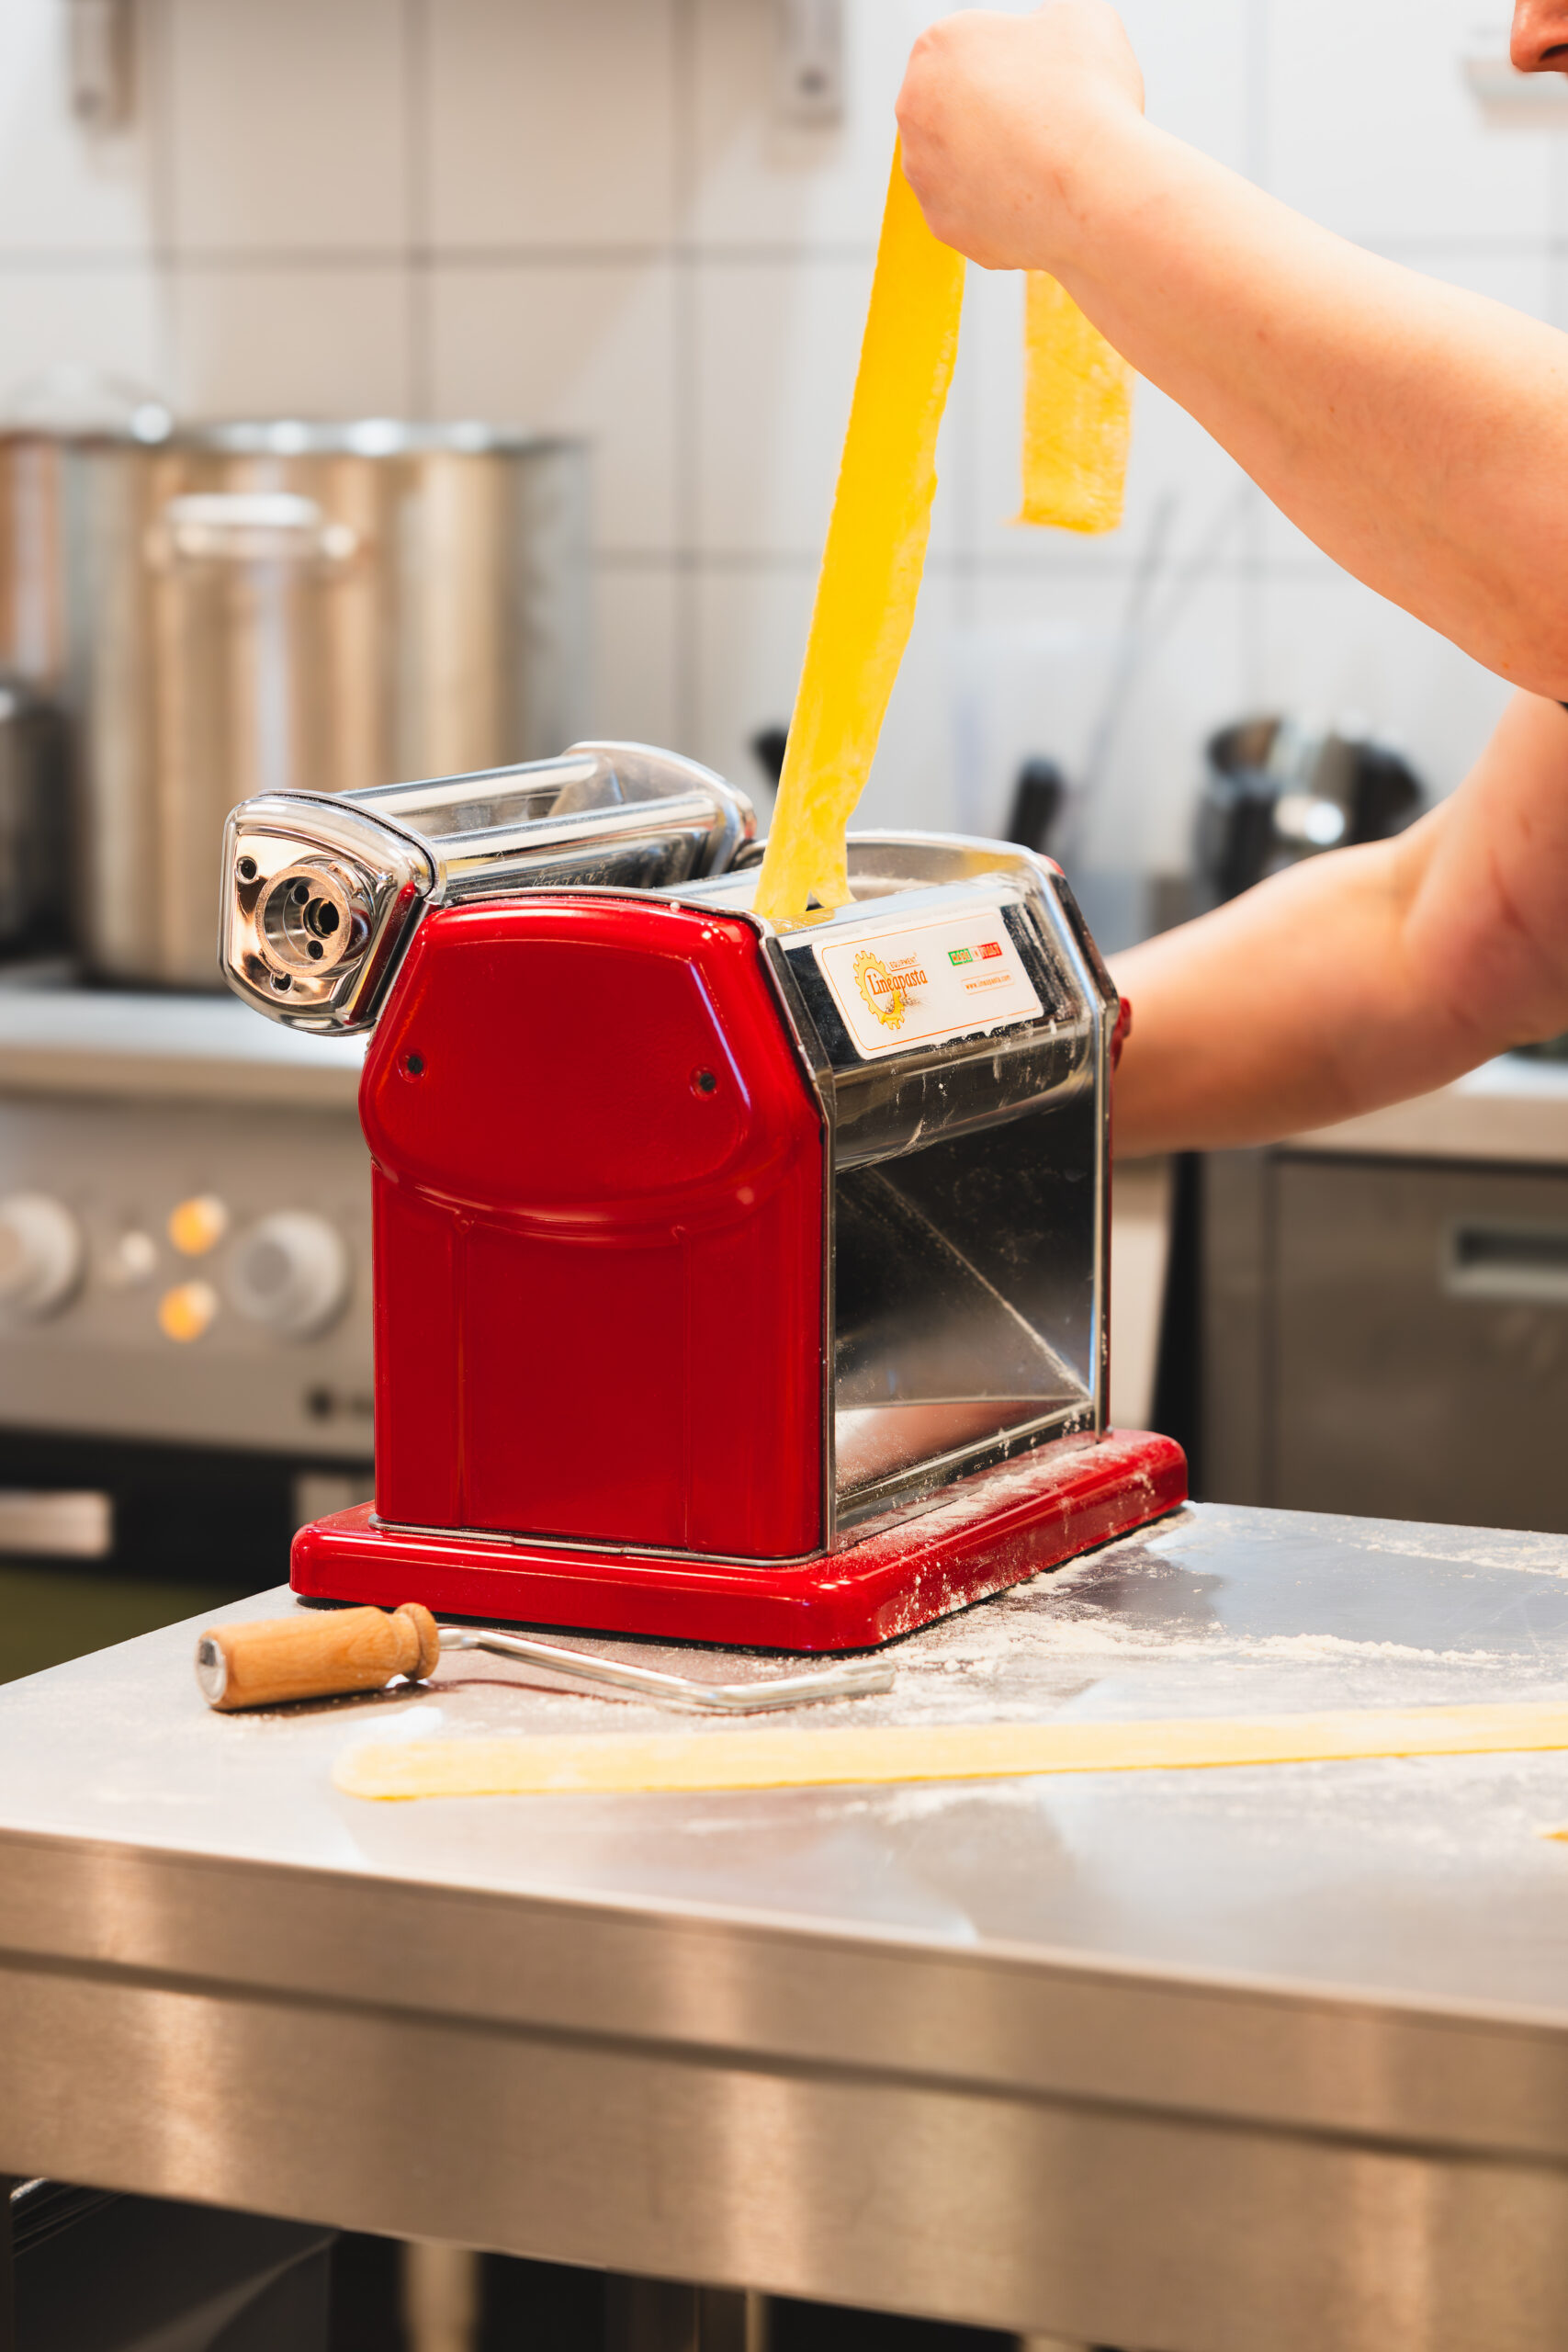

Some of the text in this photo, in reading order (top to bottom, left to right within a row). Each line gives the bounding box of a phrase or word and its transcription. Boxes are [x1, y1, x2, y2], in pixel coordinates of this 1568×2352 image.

[950, 950, 971, 963] MADE
[971, 949, 979, 958] IN
[867, 970, 928, 998] Lineapasta
